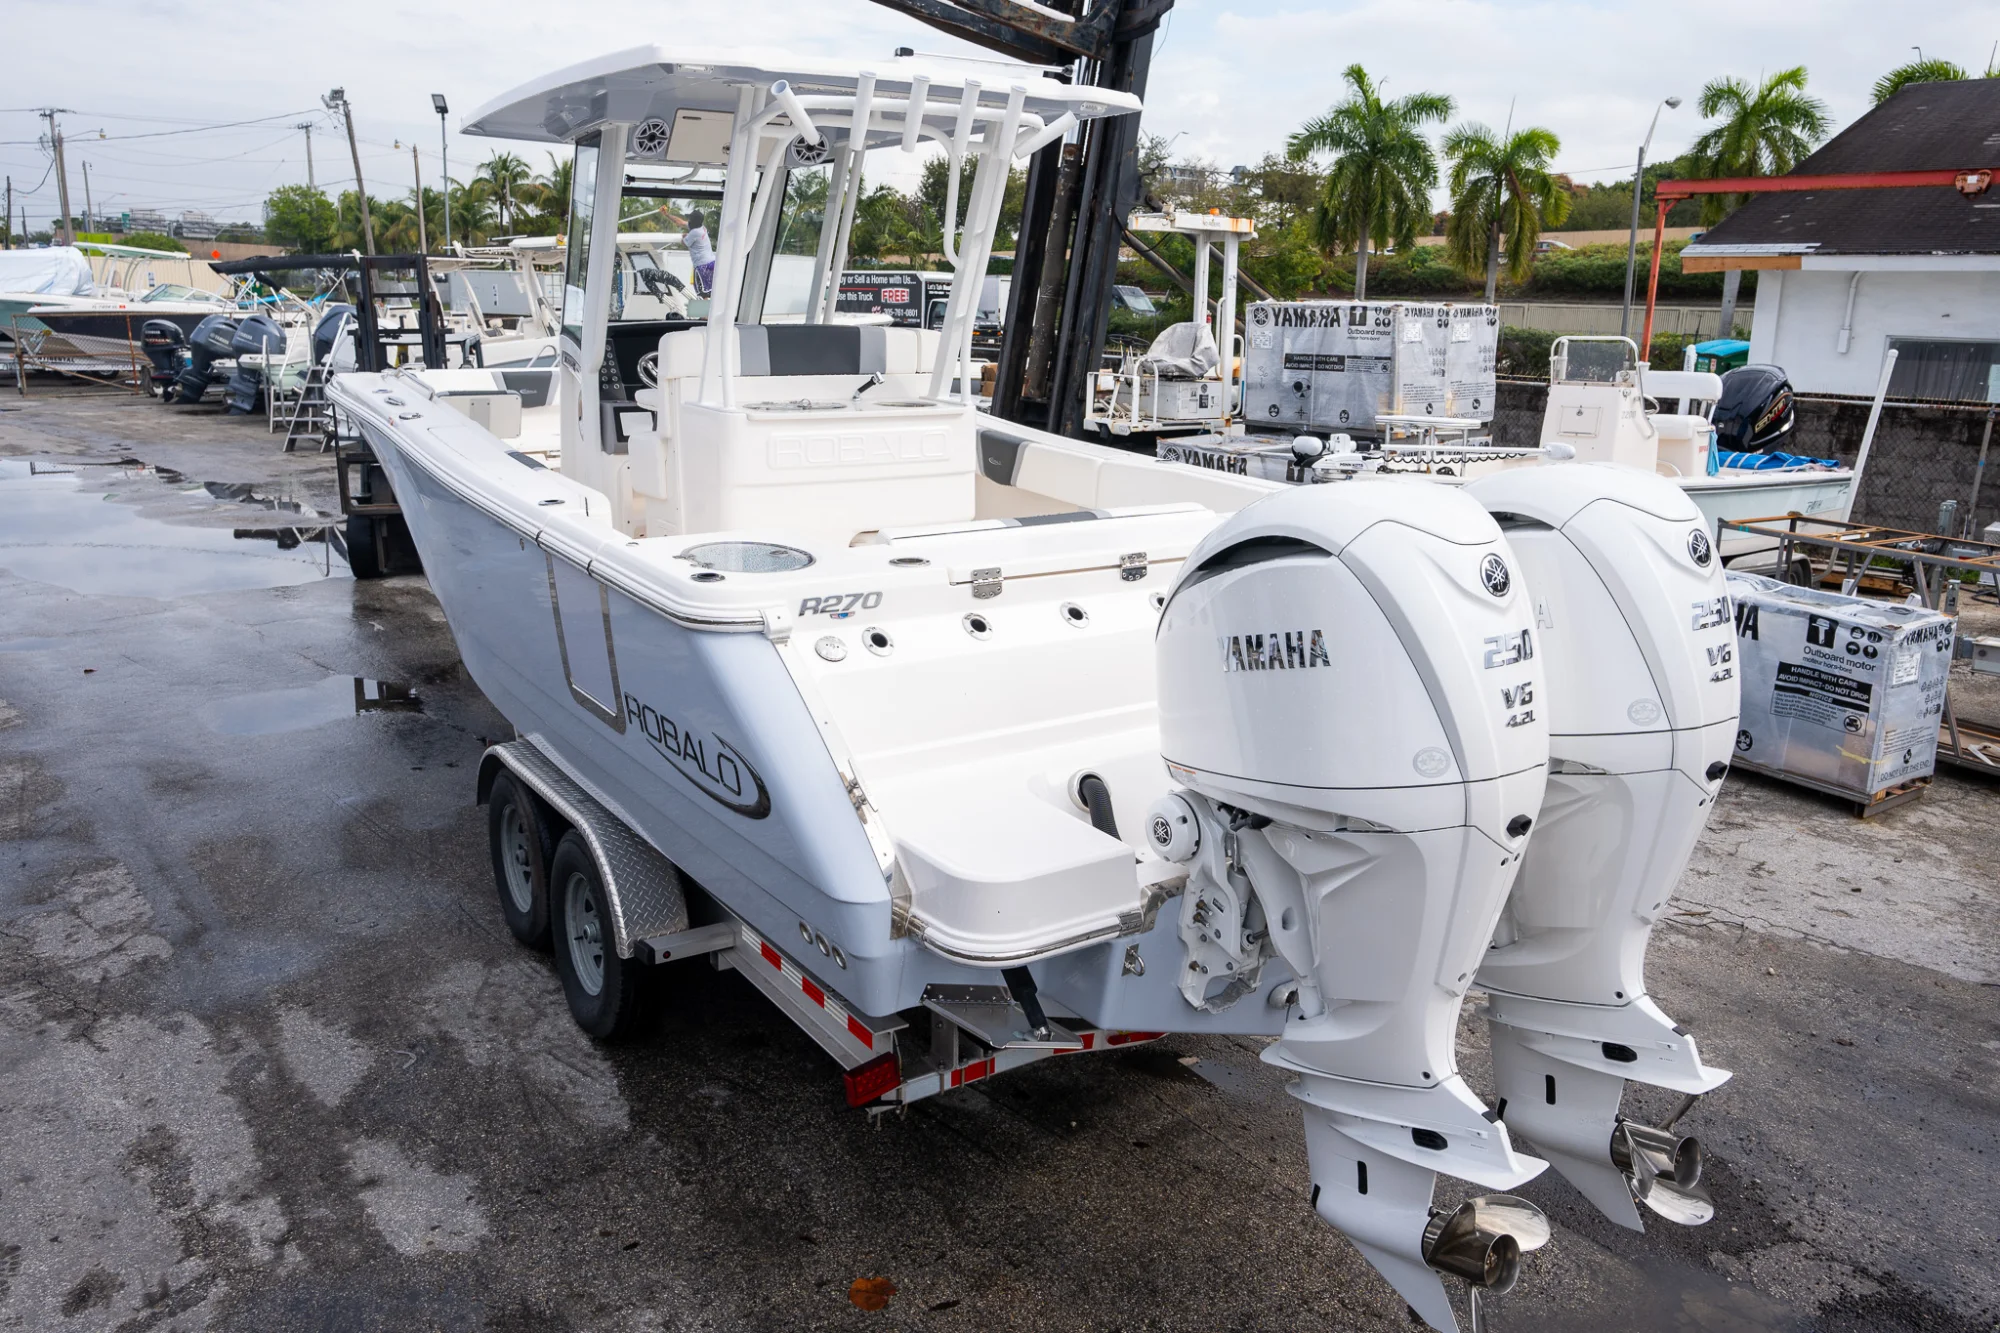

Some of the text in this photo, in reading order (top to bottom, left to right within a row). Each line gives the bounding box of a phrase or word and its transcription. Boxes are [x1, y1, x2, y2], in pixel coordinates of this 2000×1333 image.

[854, 275, 866, 284] Sell
[871, 275, 888, 284] Home
[889, 275, 902, 284] with
[847, 292, 857, 300] this
[858, 292, 874, 301] Truck
[881, 289, 909, 303] FREE!
[1272, 306, 1341, 328] YAMAHA
[1411, 307, 1435, 318] YAMAHA
[1460, 307, 1484, 318] YAMAHA
[774, 431, 948, 465] ROBALO
[1182, 449, 1248, 476] YAMAHA
[798, 591, 883, 617] R270
[1691, 596, 1731, 631] 250
[1906, 626, 1938, 645] YAMAHA
[1217, 629, 1332, 672] YAMAHA
[1483, 628, 1534, 670] 250
[1706, 642, 1731, 667] V6
[1803, 645, 1844, 664] Outboard
[1846, 657, 1876, 672] motor
[1778, 673, 1799, 682] AVOID
[1835, 686, 1849, 696] NOT
[1850, 690, 1869, 700] DROP
[1791, 666, 1858, 688] HANDLE WITH CARE
[1501, 681, 1533, 709] V6
[1808, 692, 1833, 703] NOTICE
[624, 691, 742, 796] ROBALO
[1881, 772, 1888, 780] DO
[1889, 769, 1898, 778] NOT
[1920, 760, 1930, 769] END
